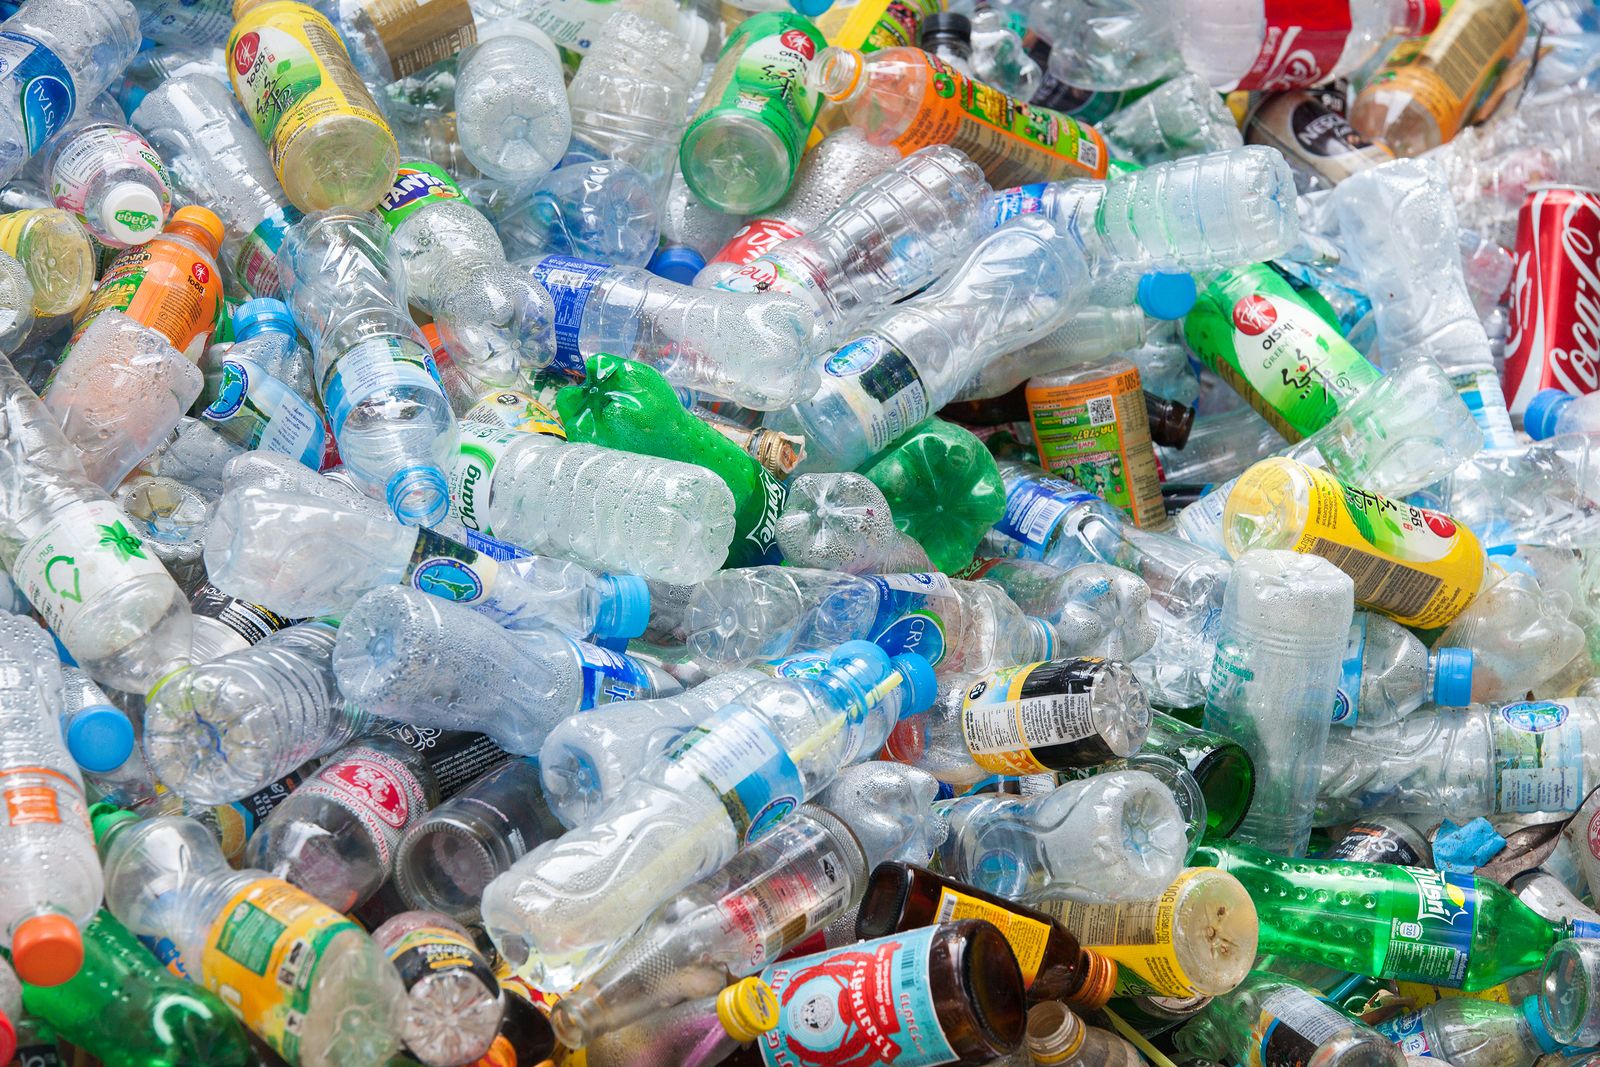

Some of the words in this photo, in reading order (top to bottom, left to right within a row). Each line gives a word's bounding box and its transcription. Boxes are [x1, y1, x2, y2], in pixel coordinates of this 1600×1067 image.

[379, 172, 446, 211] FANTA
[1262, 320, 1295, 352] OISHI
[1262, 339, 1290, 371] GREEN
[460, 463, 483, 532] Chang
[760, 471, 783, 544] Sprite
[336, 789, 367, 815] SODA
[365, 815, 389, 864] SINGHA
[1160, 885, 1180, 910] 500
[1404, 925, 1413, 938] 120
[848, 959, 893, 1059] โรงงานสุรา
[897, 992, 923, 1043] รวงข้าว
